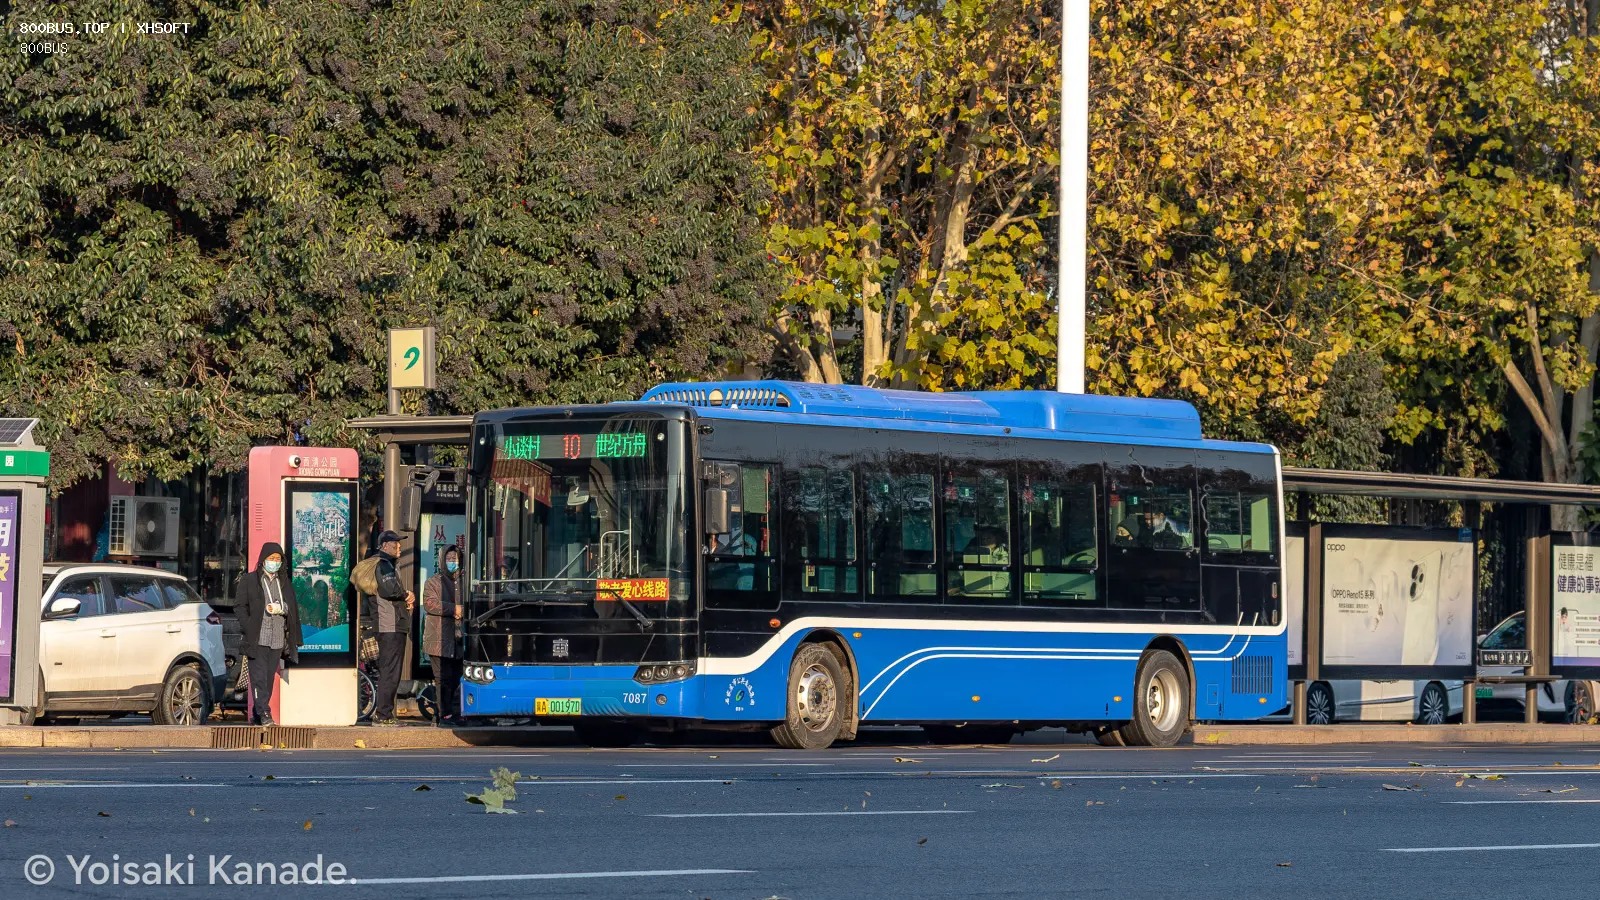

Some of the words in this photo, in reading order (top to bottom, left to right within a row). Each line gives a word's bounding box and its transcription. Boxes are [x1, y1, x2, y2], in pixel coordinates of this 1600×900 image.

[562, 434, 581, 459] 10
[595, 432, 646, 458] 世纪方舟
[1558, 552, 1594, 571] 健康是福
[1332, 589, 1347, 599] OPPO
[622, 692, 647, 704] 7087
